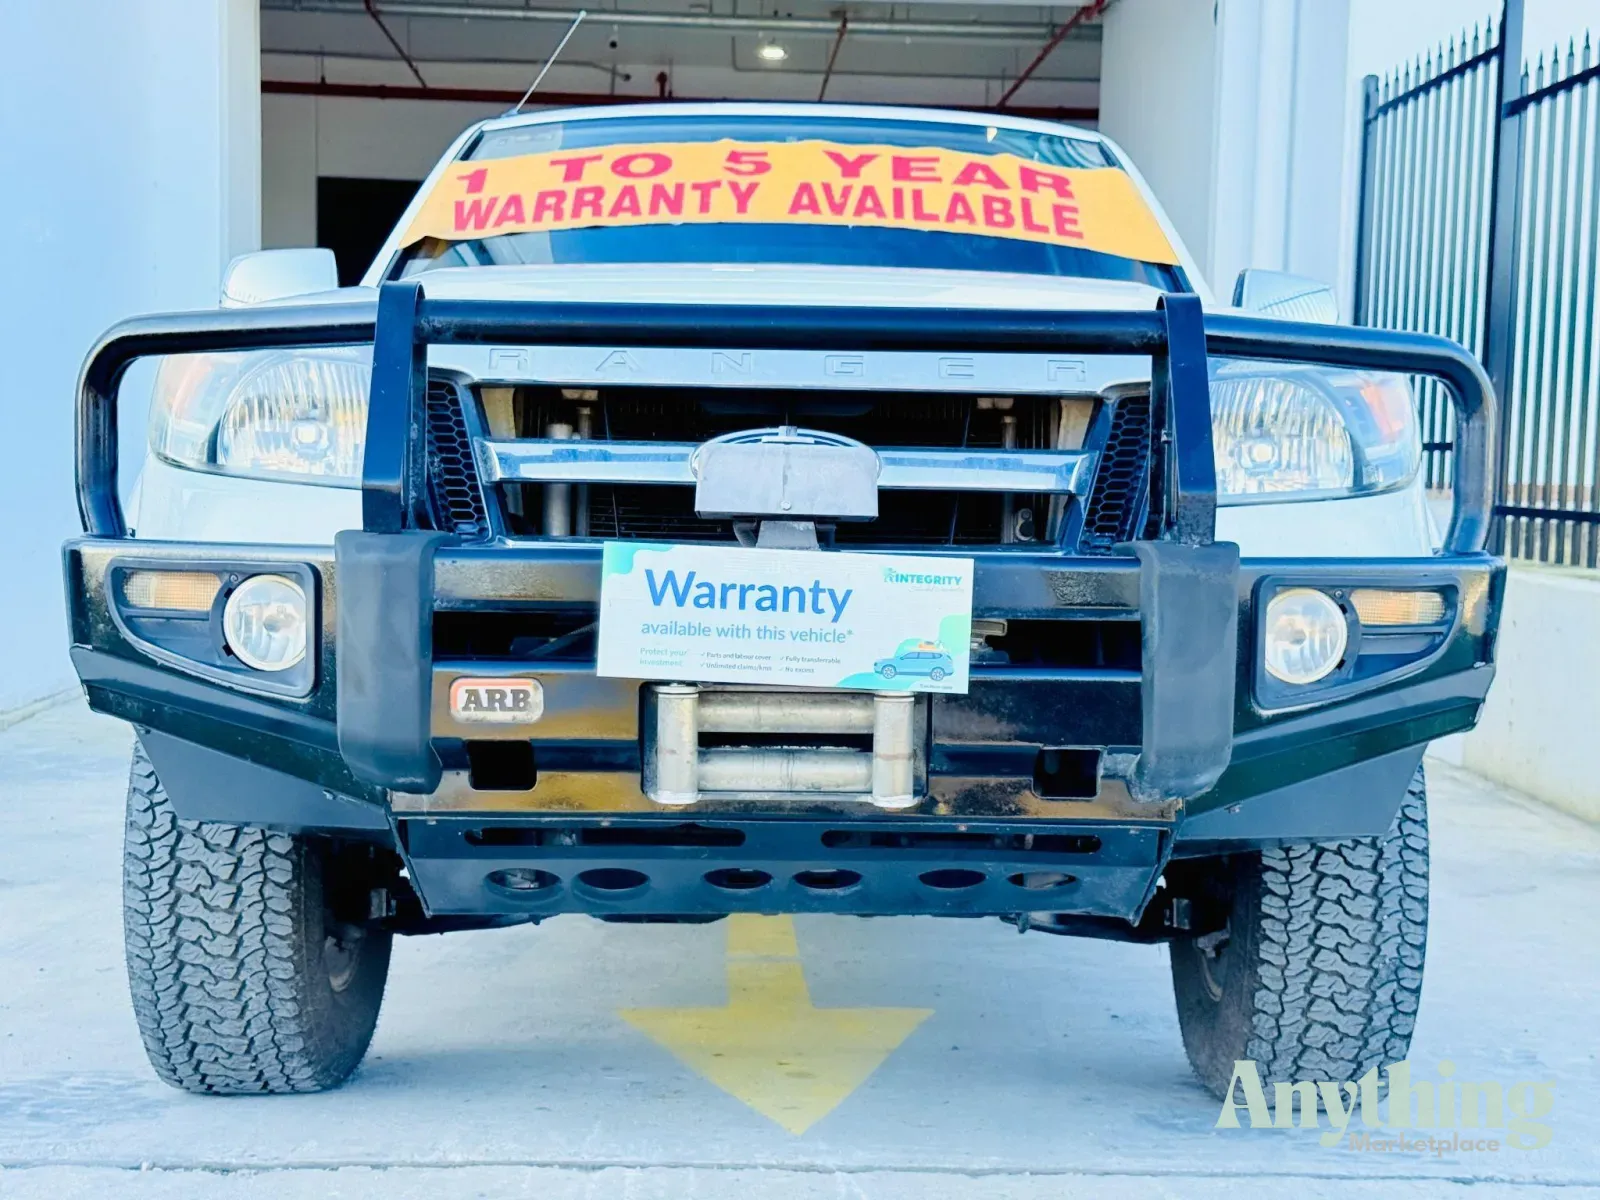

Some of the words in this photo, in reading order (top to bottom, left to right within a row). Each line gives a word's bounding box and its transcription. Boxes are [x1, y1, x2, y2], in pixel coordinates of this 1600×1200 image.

[457, 167, 488, 194] 1
[549, 150, 673, 184] TO
[723, 149, 772, 176] 5
[822, 148, 1080, 199] YEAR
[453, 181, 762, 233] WARRANTY
[786, 181, 1085, 240] AVAILABLE
[488, 347, 1087, 383] RANGER
[895, 573, 963, 586] INTEGRITY
[644, 568, 853, 623] Warranty
[641, 621, 711, 637] available
[715, 624, 751, 640] with
[756, 626, 785, 641] this
[640, 648, 668, 656] Protect
[669, 650, 688, 658] your
[706, 662, 736, 670] Unlimited
[461, 688, 531, 712] ARB
